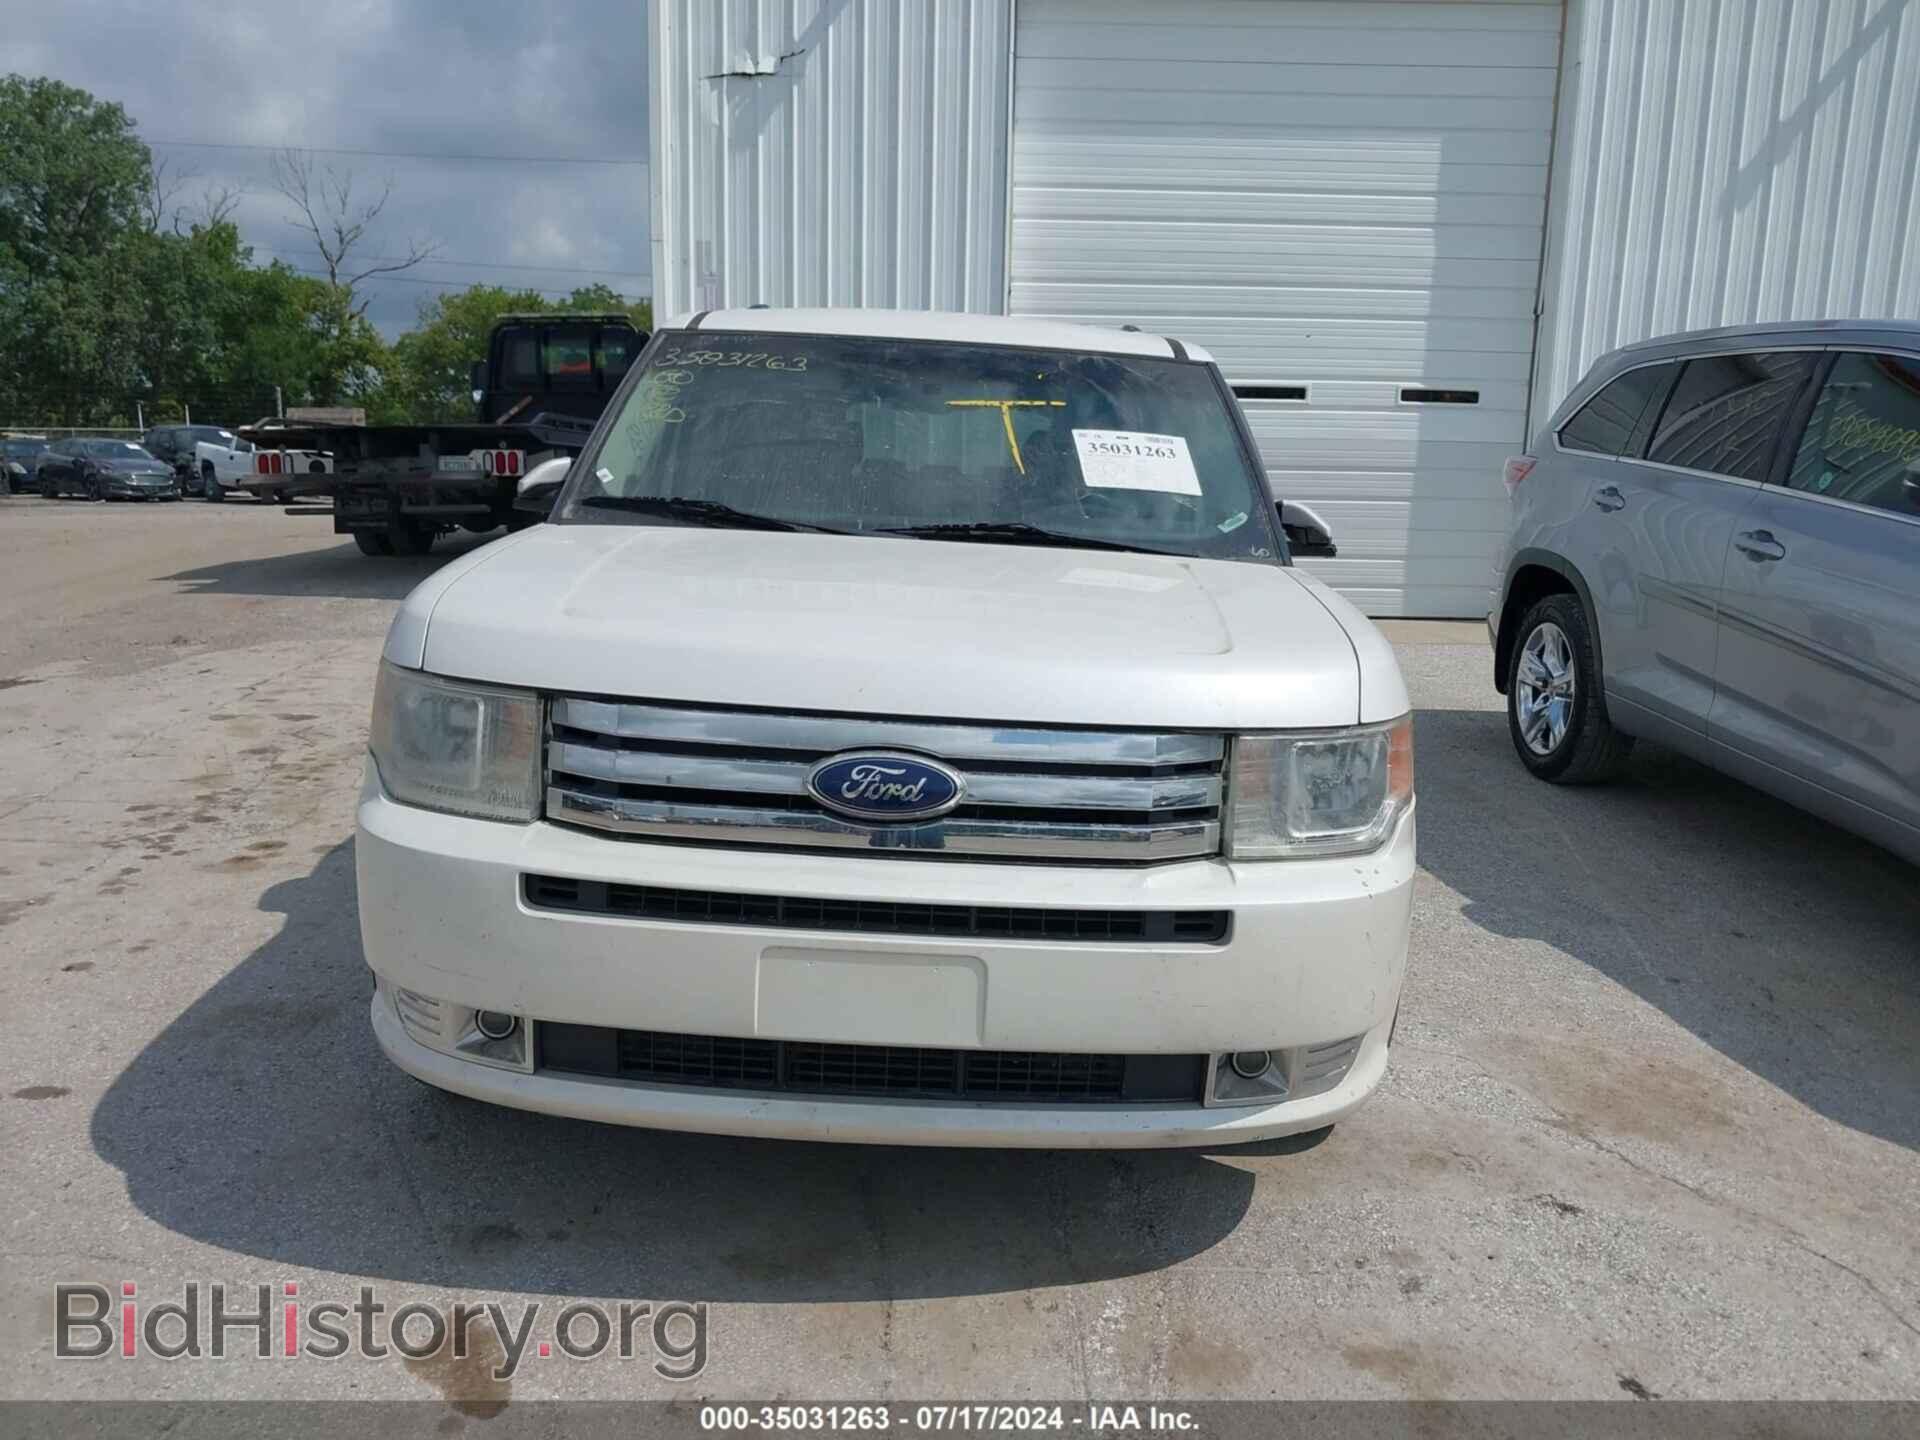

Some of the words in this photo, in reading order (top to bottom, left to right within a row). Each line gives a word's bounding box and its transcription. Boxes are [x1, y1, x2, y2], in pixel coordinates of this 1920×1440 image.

[655, 347, 808, 372] 35031263
[1088, 442, 1177, 459] 35031263
[841, 764, 928, 802] Ford
